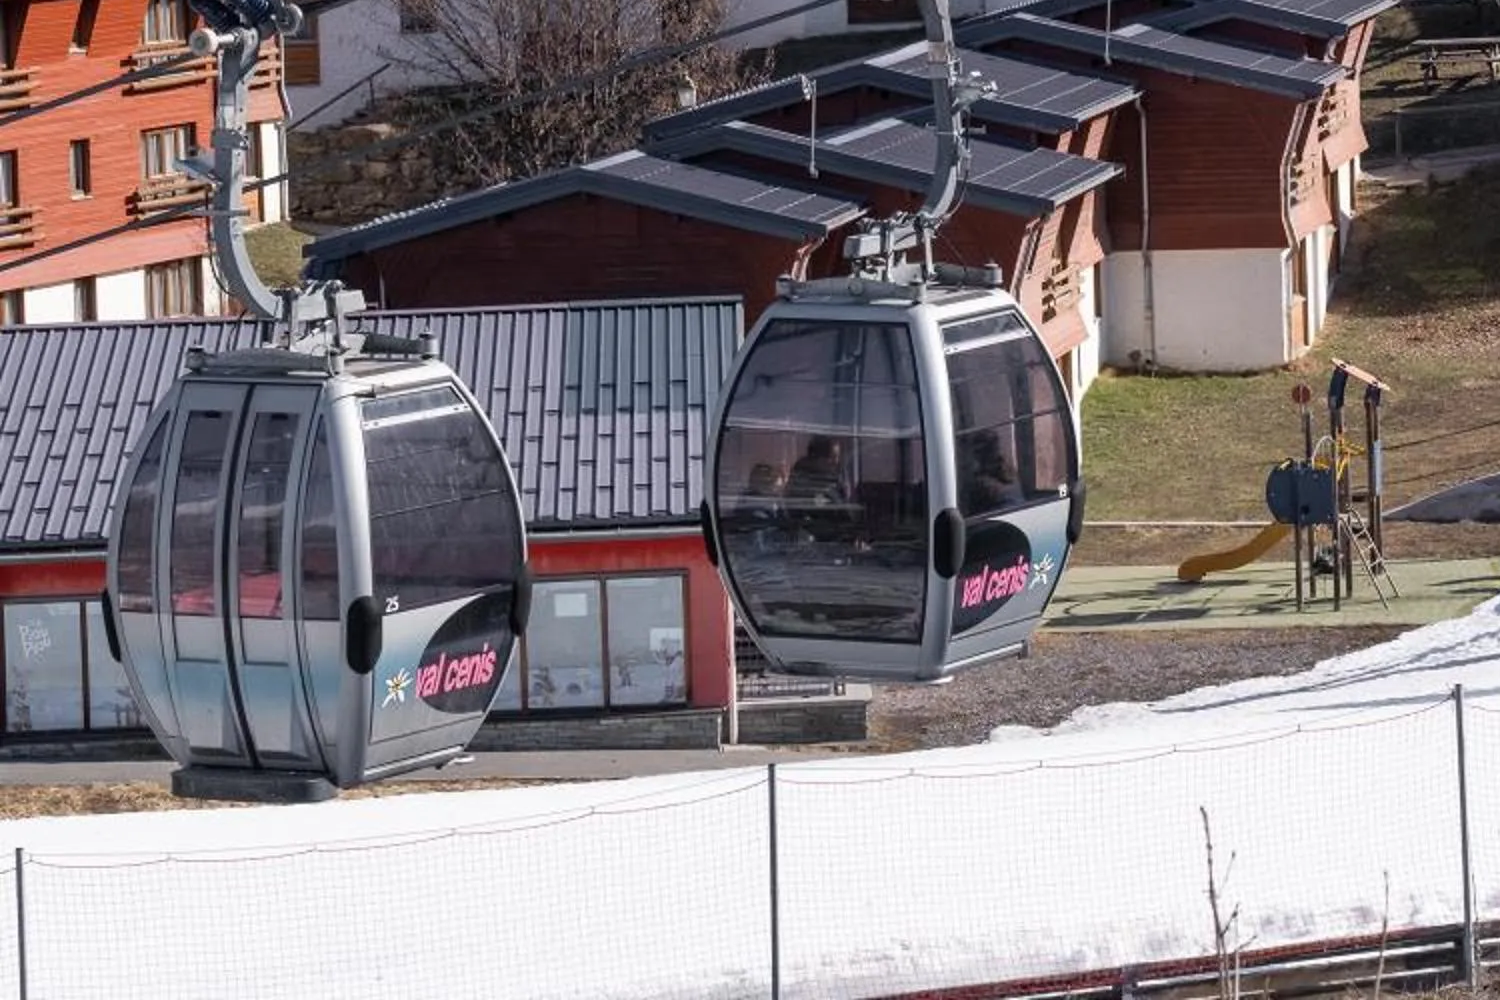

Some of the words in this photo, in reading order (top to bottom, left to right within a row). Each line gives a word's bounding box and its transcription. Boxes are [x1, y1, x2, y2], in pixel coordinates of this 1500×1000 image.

[385, 595, 400, 613] 25
[960, 564, 989, 608] val
[985, 555, 1030, 602] cenis
[415, 652, 447, 699] val
[444, 642, 497, 692] cenis
